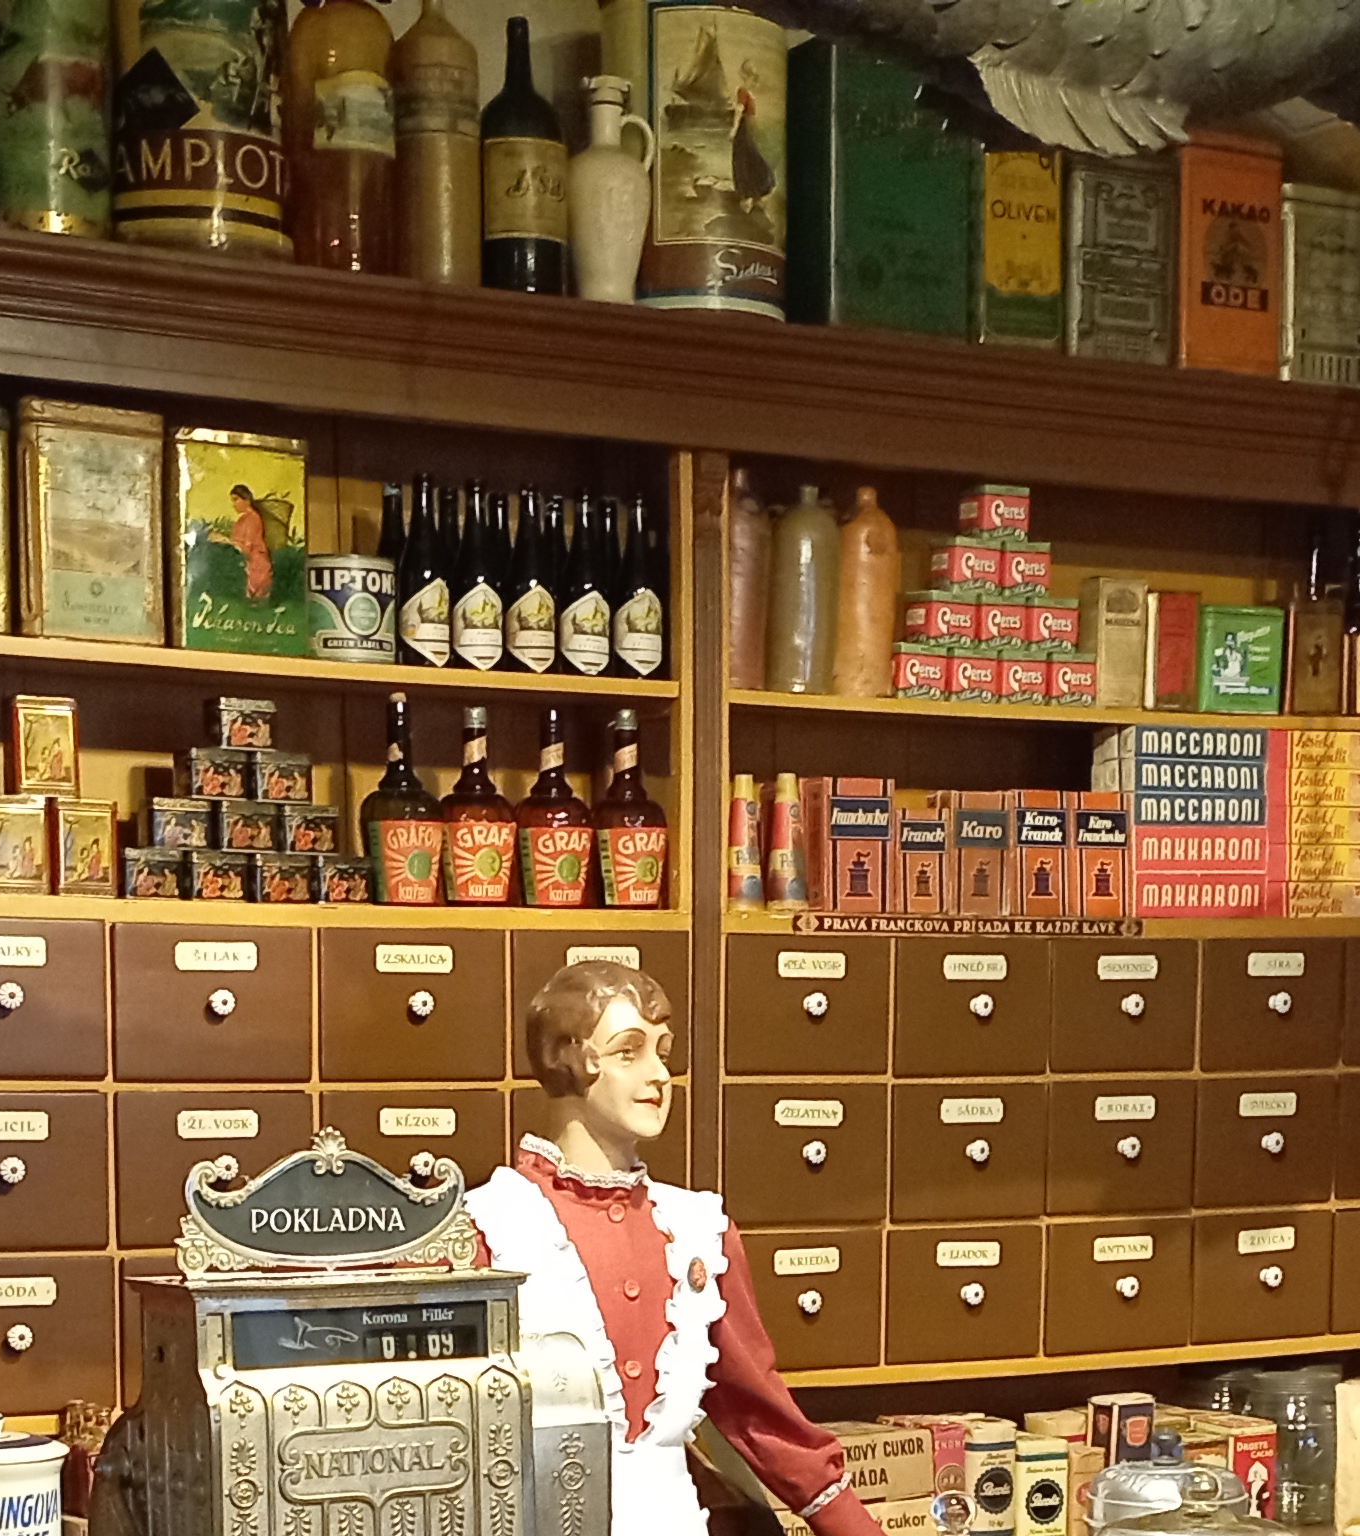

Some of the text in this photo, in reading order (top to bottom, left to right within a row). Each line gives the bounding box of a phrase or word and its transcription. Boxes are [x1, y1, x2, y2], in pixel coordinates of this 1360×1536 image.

[1201, 198, 1271, 224] KAKAO
[1141, 730, 1262, 757] MACCARONI
[1141, 763, 1259, 790] MACCARONI
[1023, 811, 1062, 826] Karo-
[1141, 797, 1260, 822] MACCARONI
[901, 826, 945, 843] Franck
[960, 820, 1003, 840] Karo
[1021, 826, 1063, 843] Franck
[1142, 836, 1261, 862] MAKKARONI
[1142, 883, 1260, 908] MAKKARONI
[823, 916, 868, 931] PRAVÁ
[871, 919, 949, 932] FRANCKOVA
[1014, 921, 1032, 934] KE
[193, 947, 240, 963] ŠELAK
[957, 1102, 994, 1117] SÁDRA
[1106, 1102, 1146, 1114] BORAX
[214, 1118, 250, 1131] VOSK
[250, 1206, 406, 1234] POKLADNA
[789, 1254, 831, 1267] KRIEDA
[362, 1309, 408, 1325] Korona
[844, 1439, 877, 1463] KOVÝ
[883, 1436, 925, 1458] CUKOR
[303, 1443, 443, 1480] NATIONAL
[886, 1511, 927, 1529] cukor
